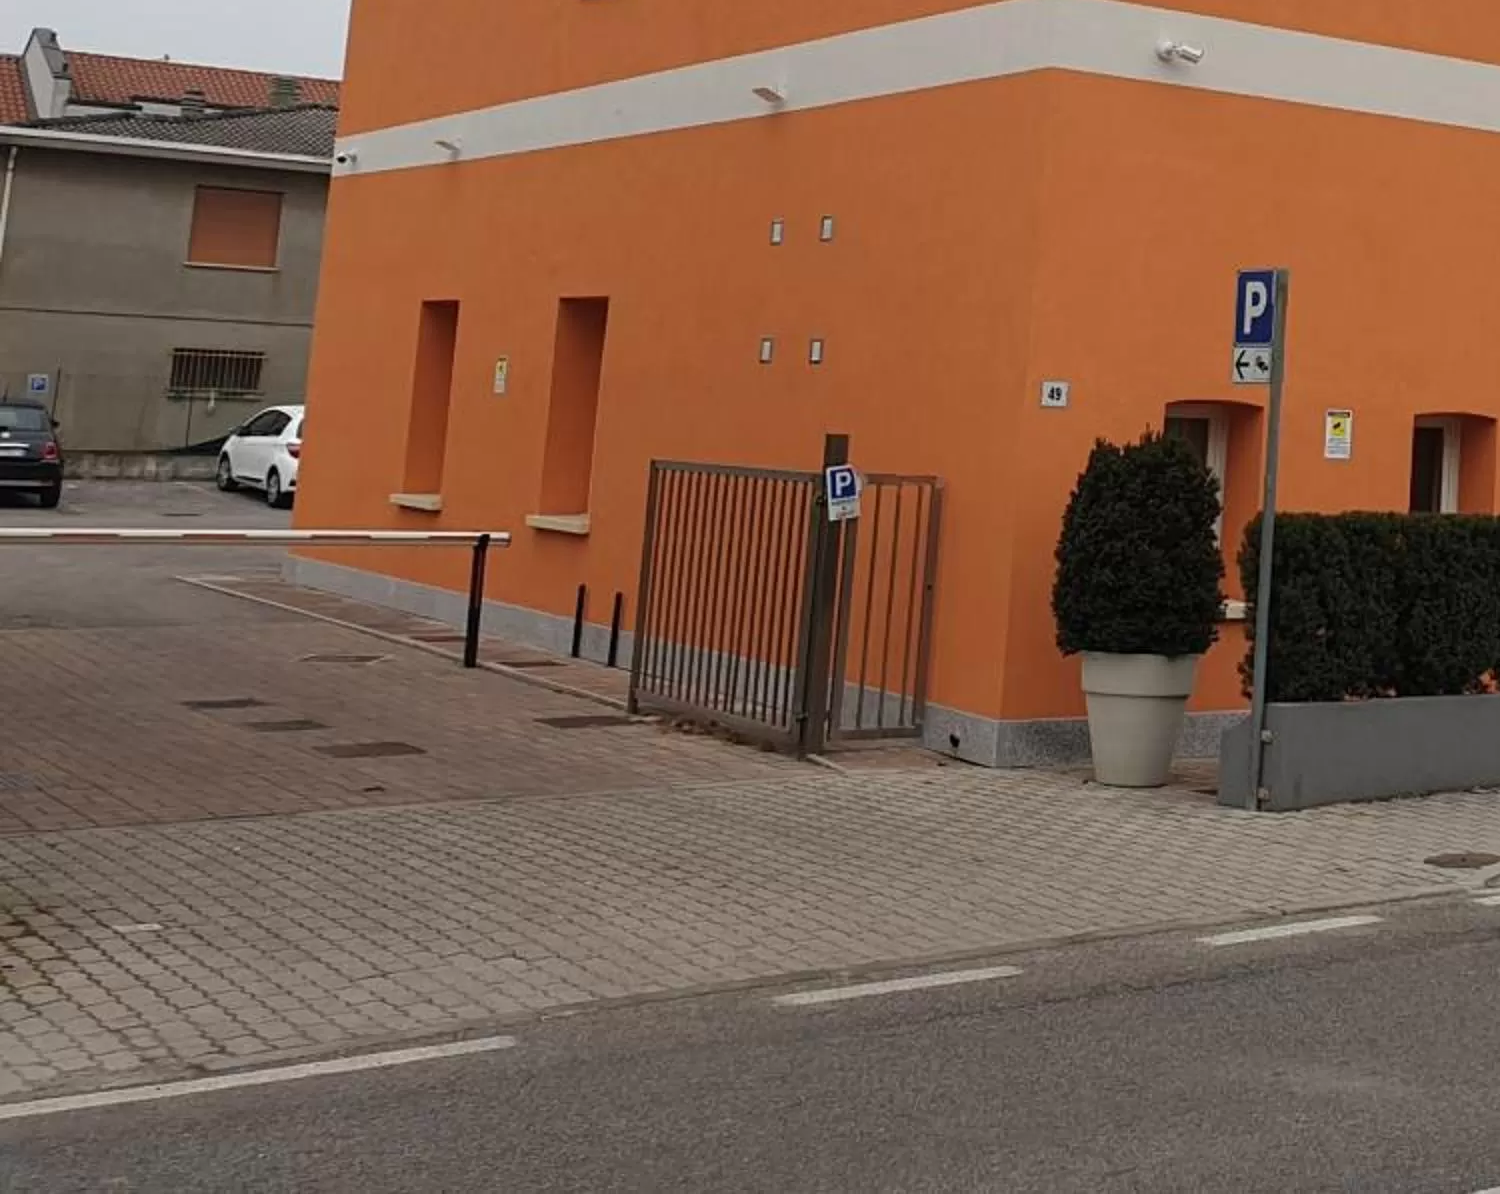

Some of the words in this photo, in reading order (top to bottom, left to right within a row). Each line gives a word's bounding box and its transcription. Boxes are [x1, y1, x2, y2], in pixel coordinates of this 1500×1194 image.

[1243, 281, 1267, 335] P
[1048, 386, 1062, 401] 49
[835, 472, 852, 496] P
